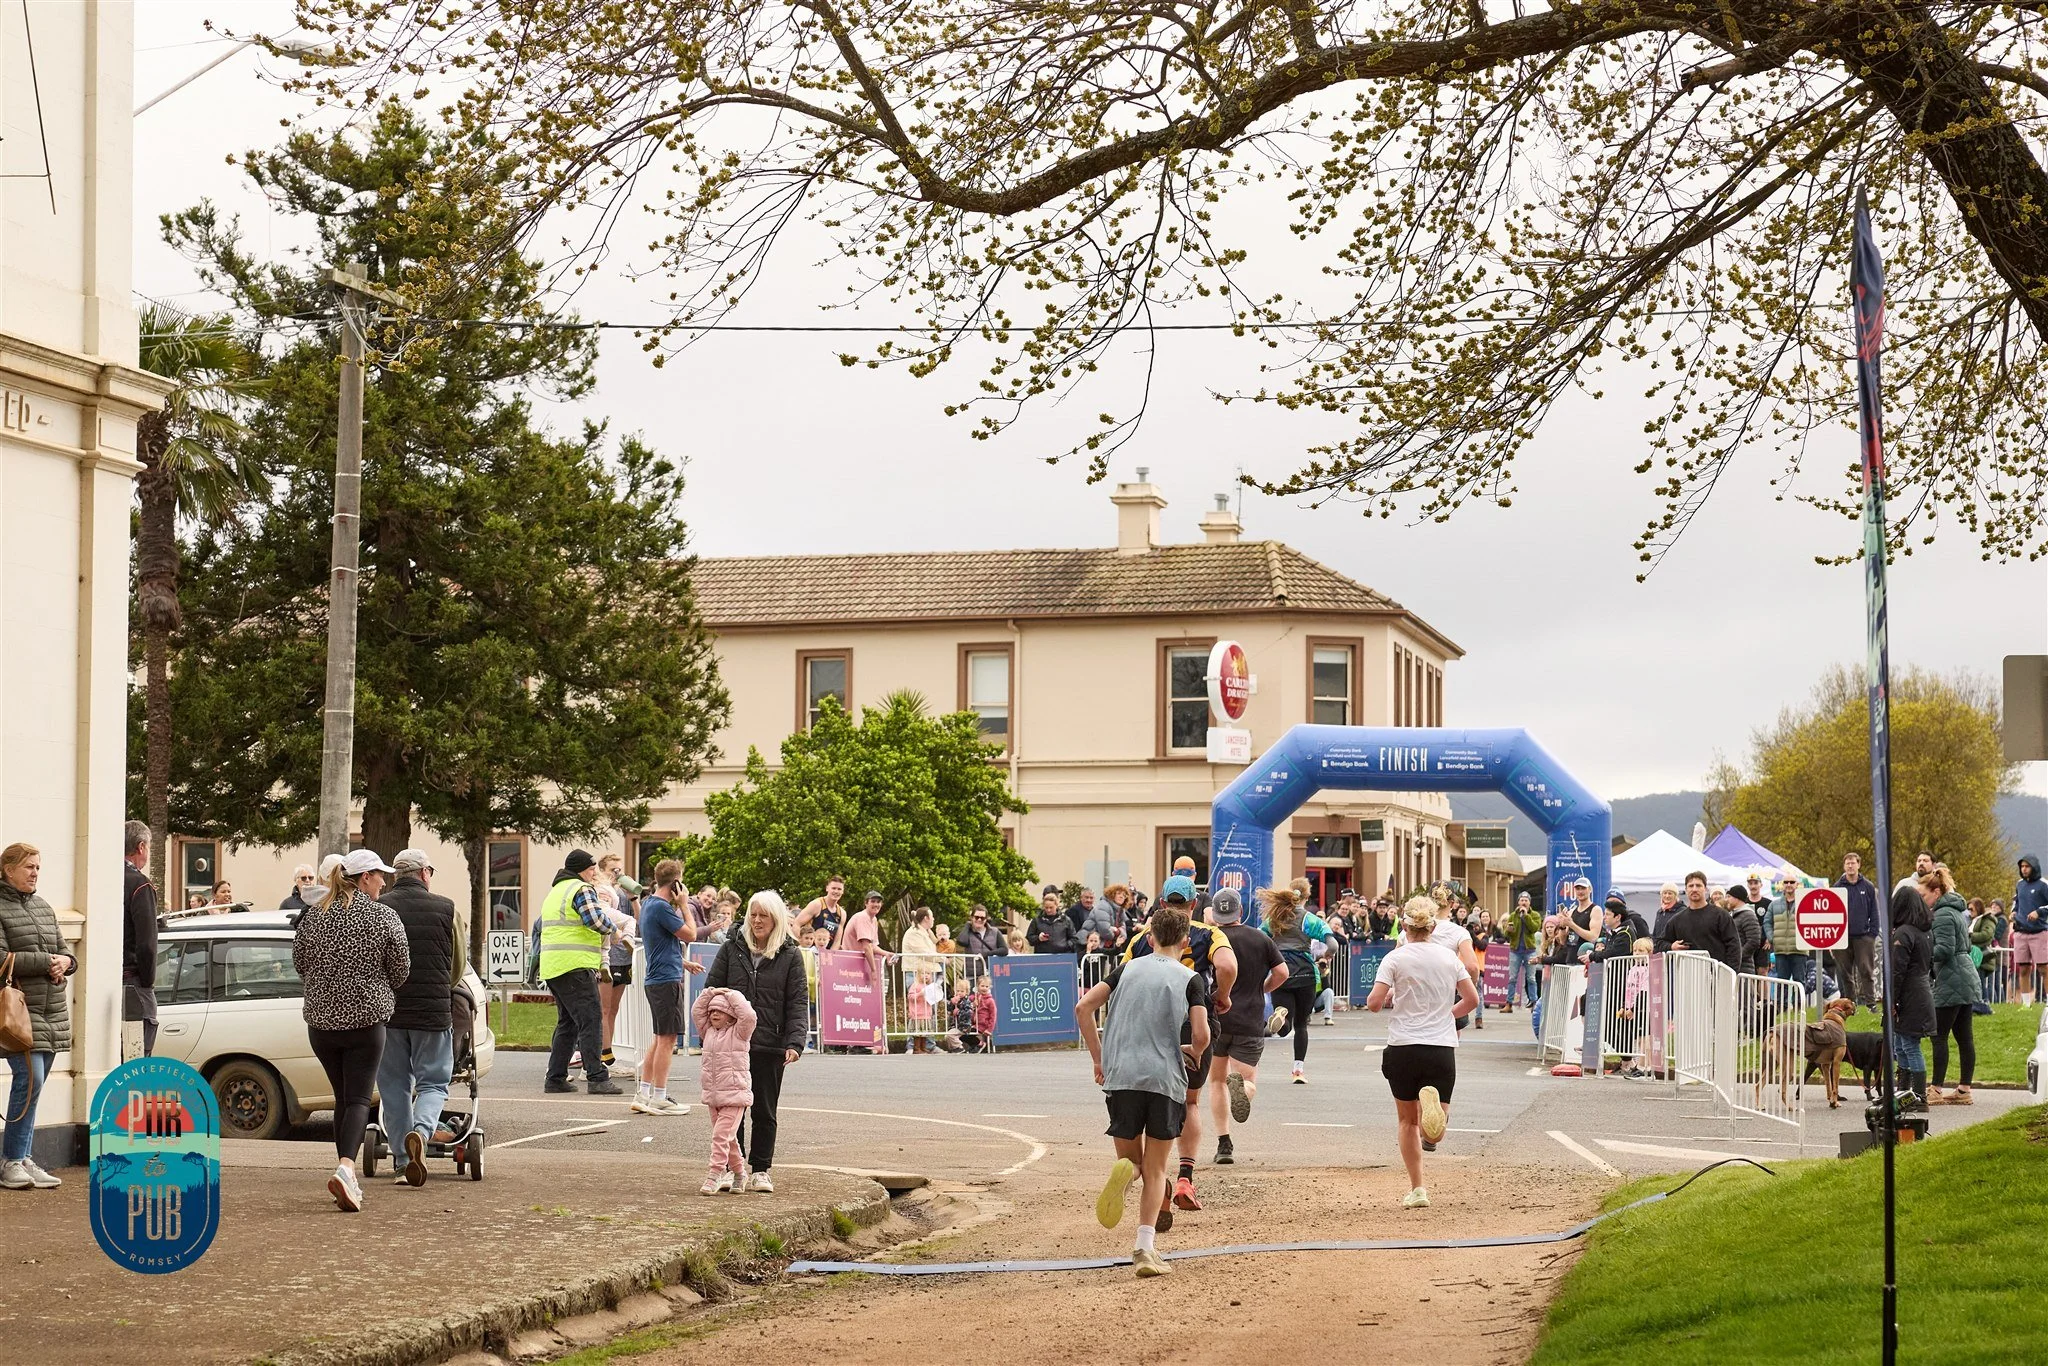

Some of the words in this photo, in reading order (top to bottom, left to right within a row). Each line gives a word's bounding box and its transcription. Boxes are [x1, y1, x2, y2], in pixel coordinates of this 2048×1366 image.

[1330, 760, 1353, 768] Bendigo
[1379, 747, 1428, 772] FINISH
[1223, 871, 1243, 891] PUB
[1563, 881, 1577, 901] PU
[1813, 898, 1830, 911] NO
[1803, 926, 1840, 939] ENTRY
[493, 936, 519, 948] ONE
[491, 952, 520, 964] WAY
[1010, 986, 1060, 1015] 1860
[842, 1017, 860, 1033] Bendigo
[859, 1018, 871, 1030] Bank
